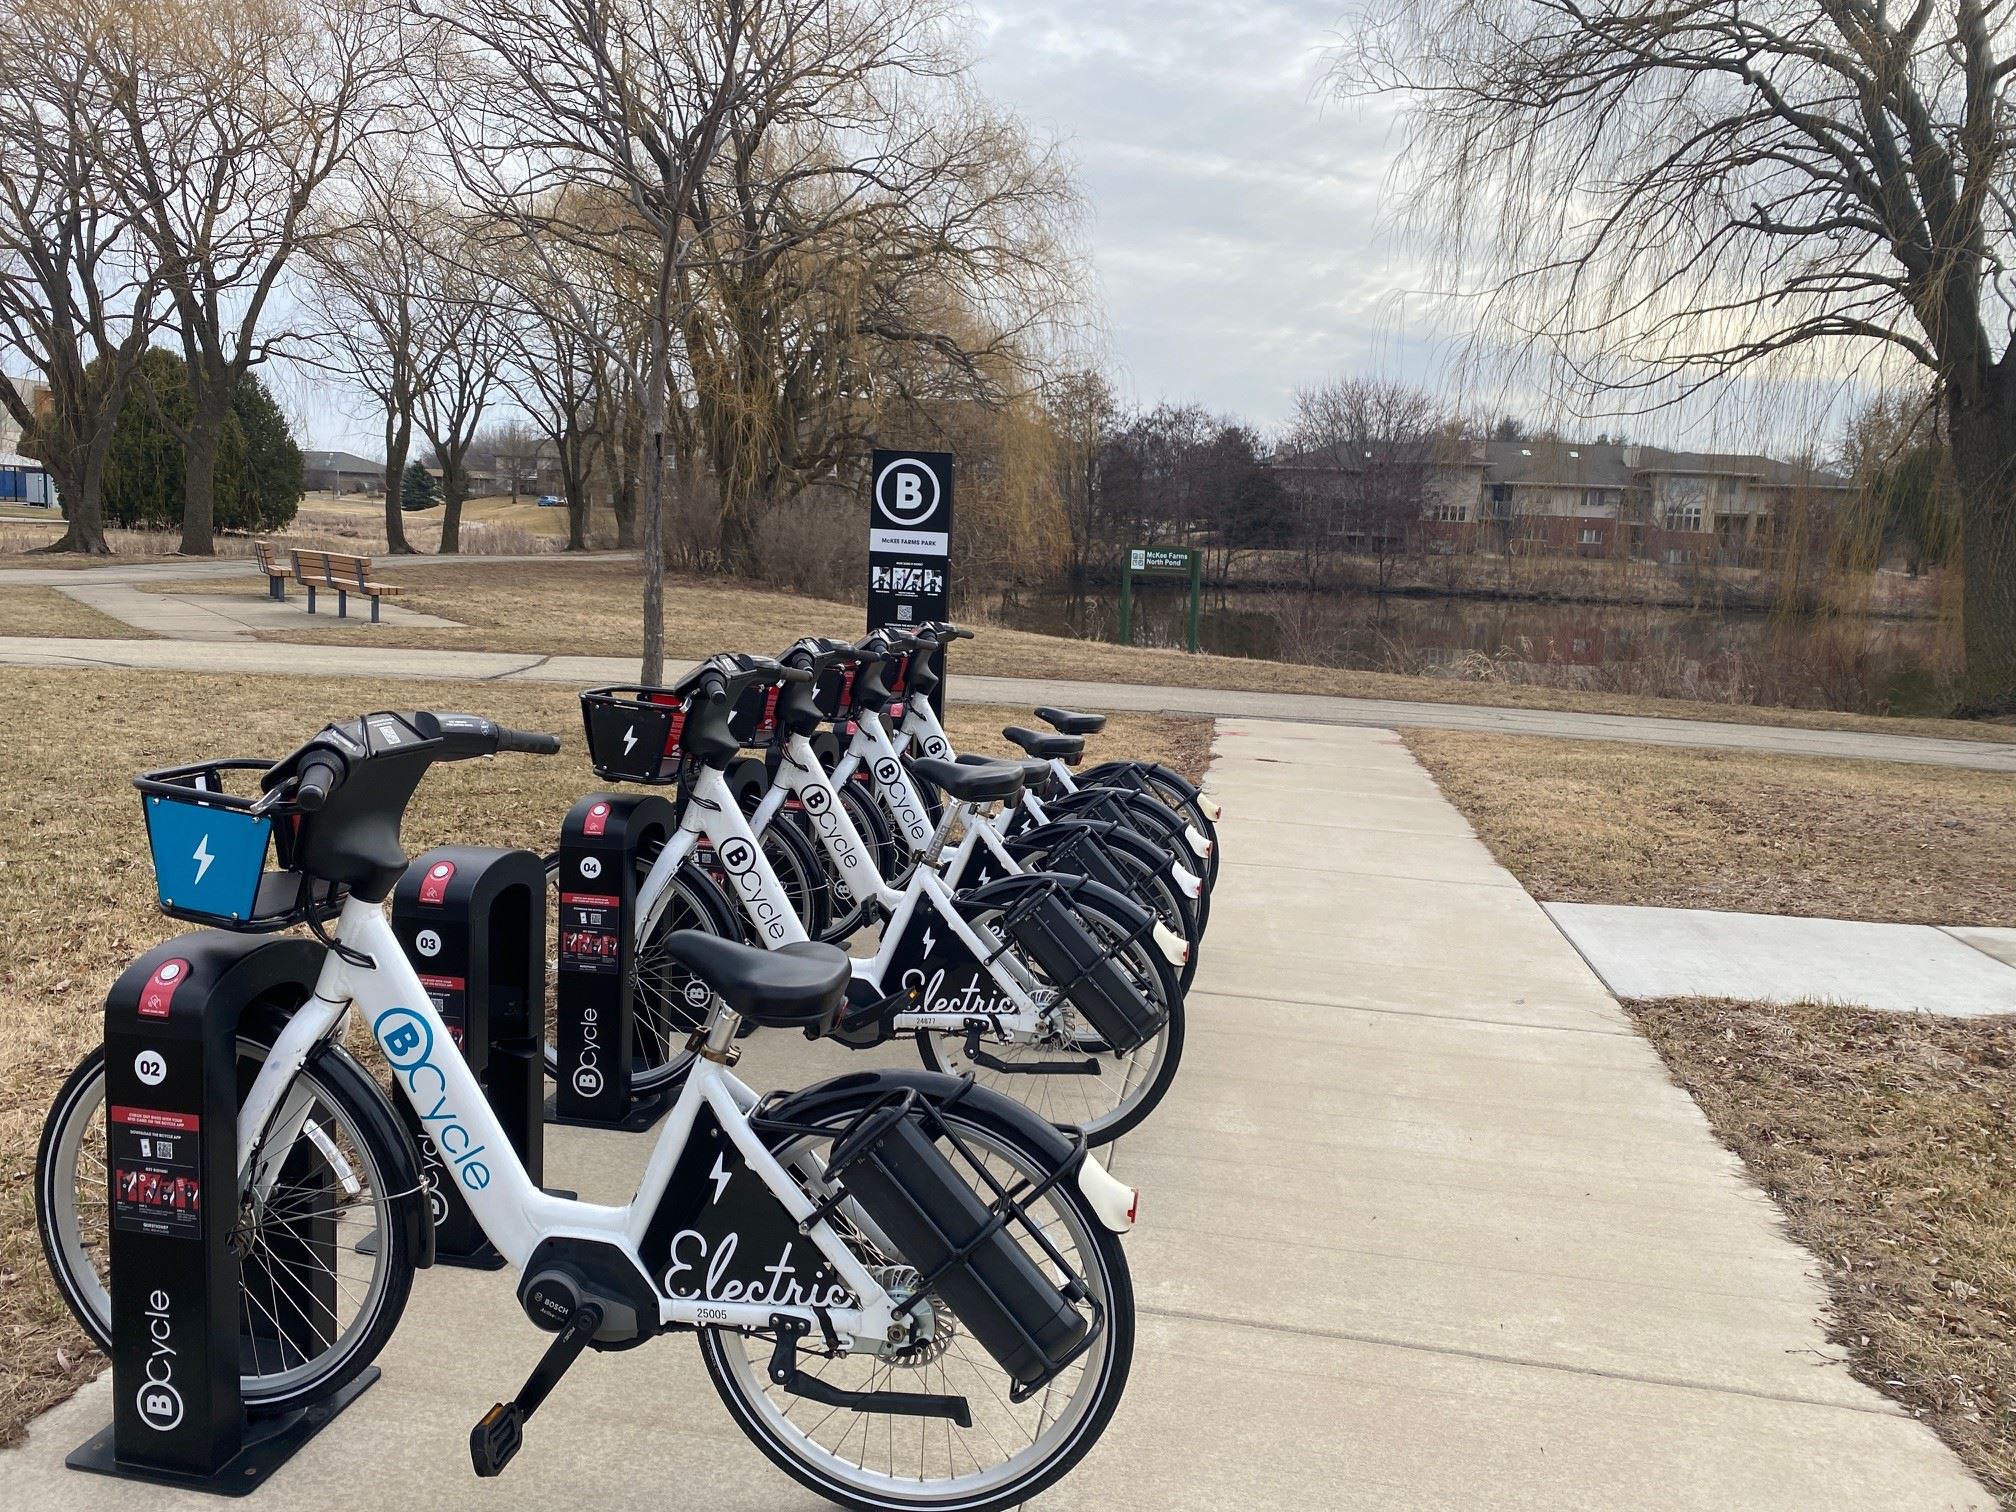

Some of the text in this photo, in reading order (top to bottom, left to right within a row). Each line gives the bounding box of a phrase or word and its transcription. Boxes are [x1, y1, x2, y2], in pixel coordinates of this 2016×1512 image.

[900, 538, 920, 546] FARMS
[920, 539, 937, 547] PARK
[1146, 551, 1188, 560] McKee Farms
[1146, 558, 1182, 567] North Pond
[583, 862, 598, 874] 04
[420, 937, 436, 950] 03
[140, 1060, 161, 1077] 02
[664, 1229, 853, 1308] Electric
[544, 1298, 569, 1315] BOSCH
[697, 1307, 728, 1320] 25005
